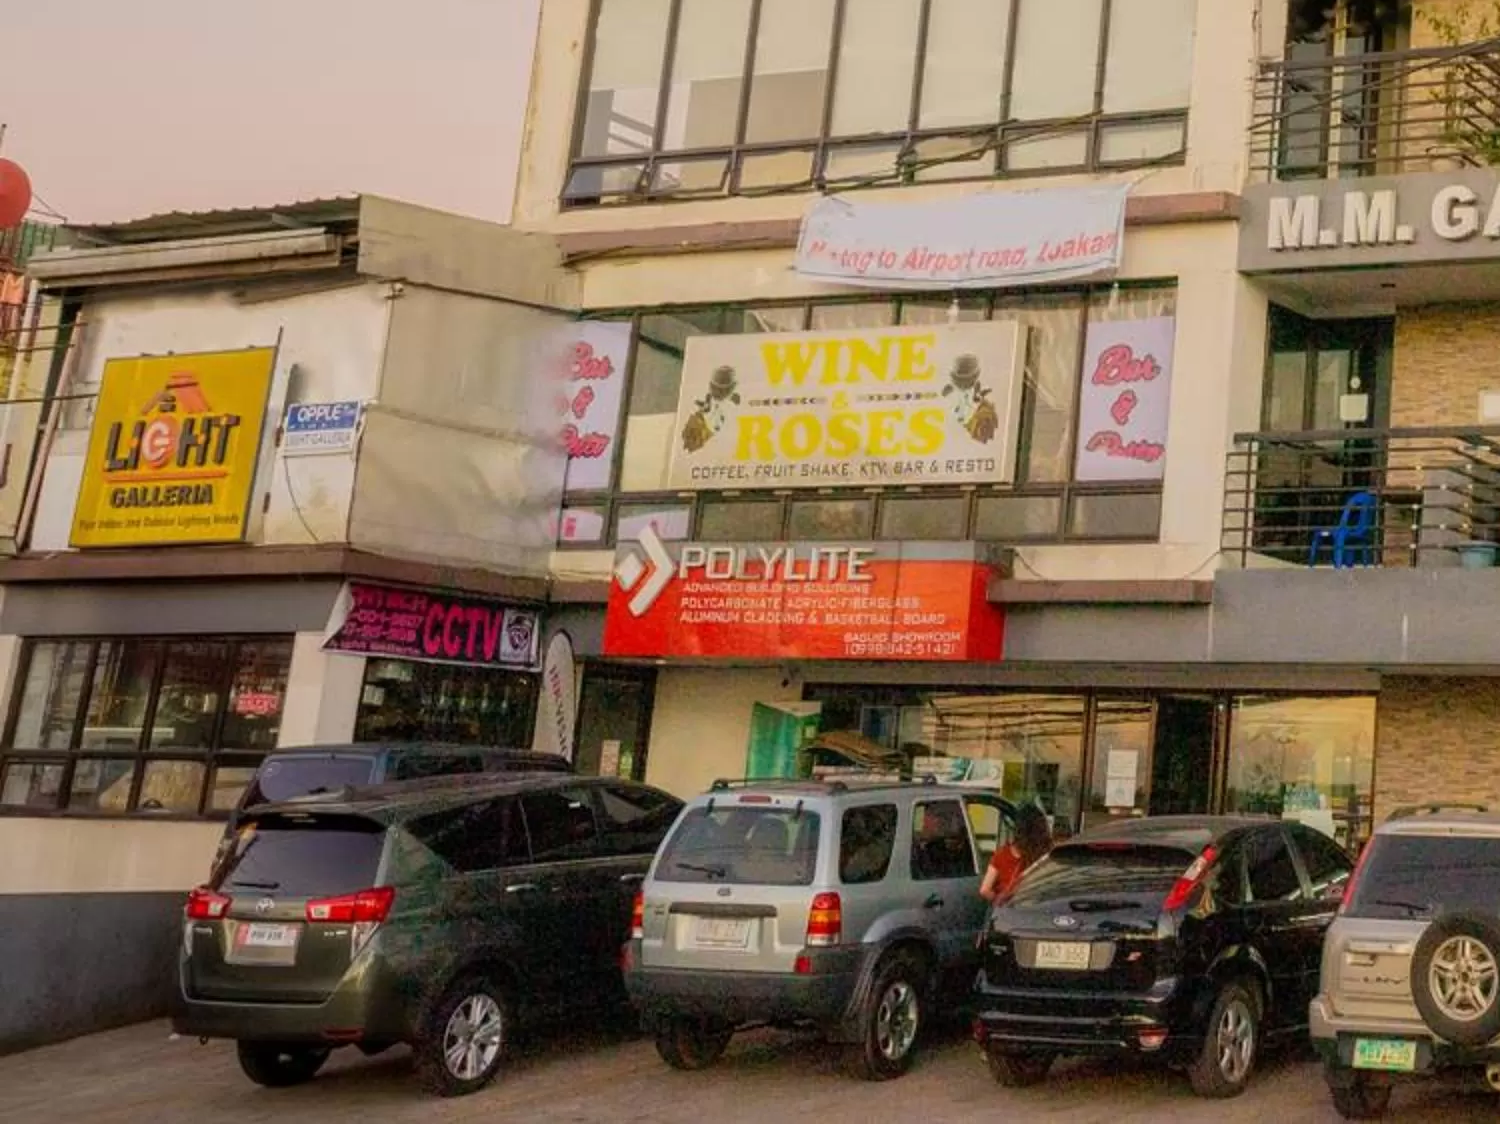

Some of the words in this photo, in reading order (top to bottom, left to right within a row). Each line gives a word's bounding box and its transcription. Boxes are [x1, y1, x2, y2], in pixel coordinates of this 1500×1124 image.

[1267, 189, 1416, 250] M.M.
[759, 333, 937, 387] WINE
[297, 404, 342, 423] OPPLE
[831, 390, 849, 410] &
[105, 413, 241, 473] LIGHT
[732, 408, 947, 462] ROSES
[753, 464, 797, 478] FRUIT
[893, 460, 924, 474] BAR
[928, 459, 939, 473] &
[945, 459, 996, 473] RESTO
[110, 483, 213, 509] GALLERIA
[678, 546, 876, 582] POLYLITE
[422, 602, 501, 663] CCTV
